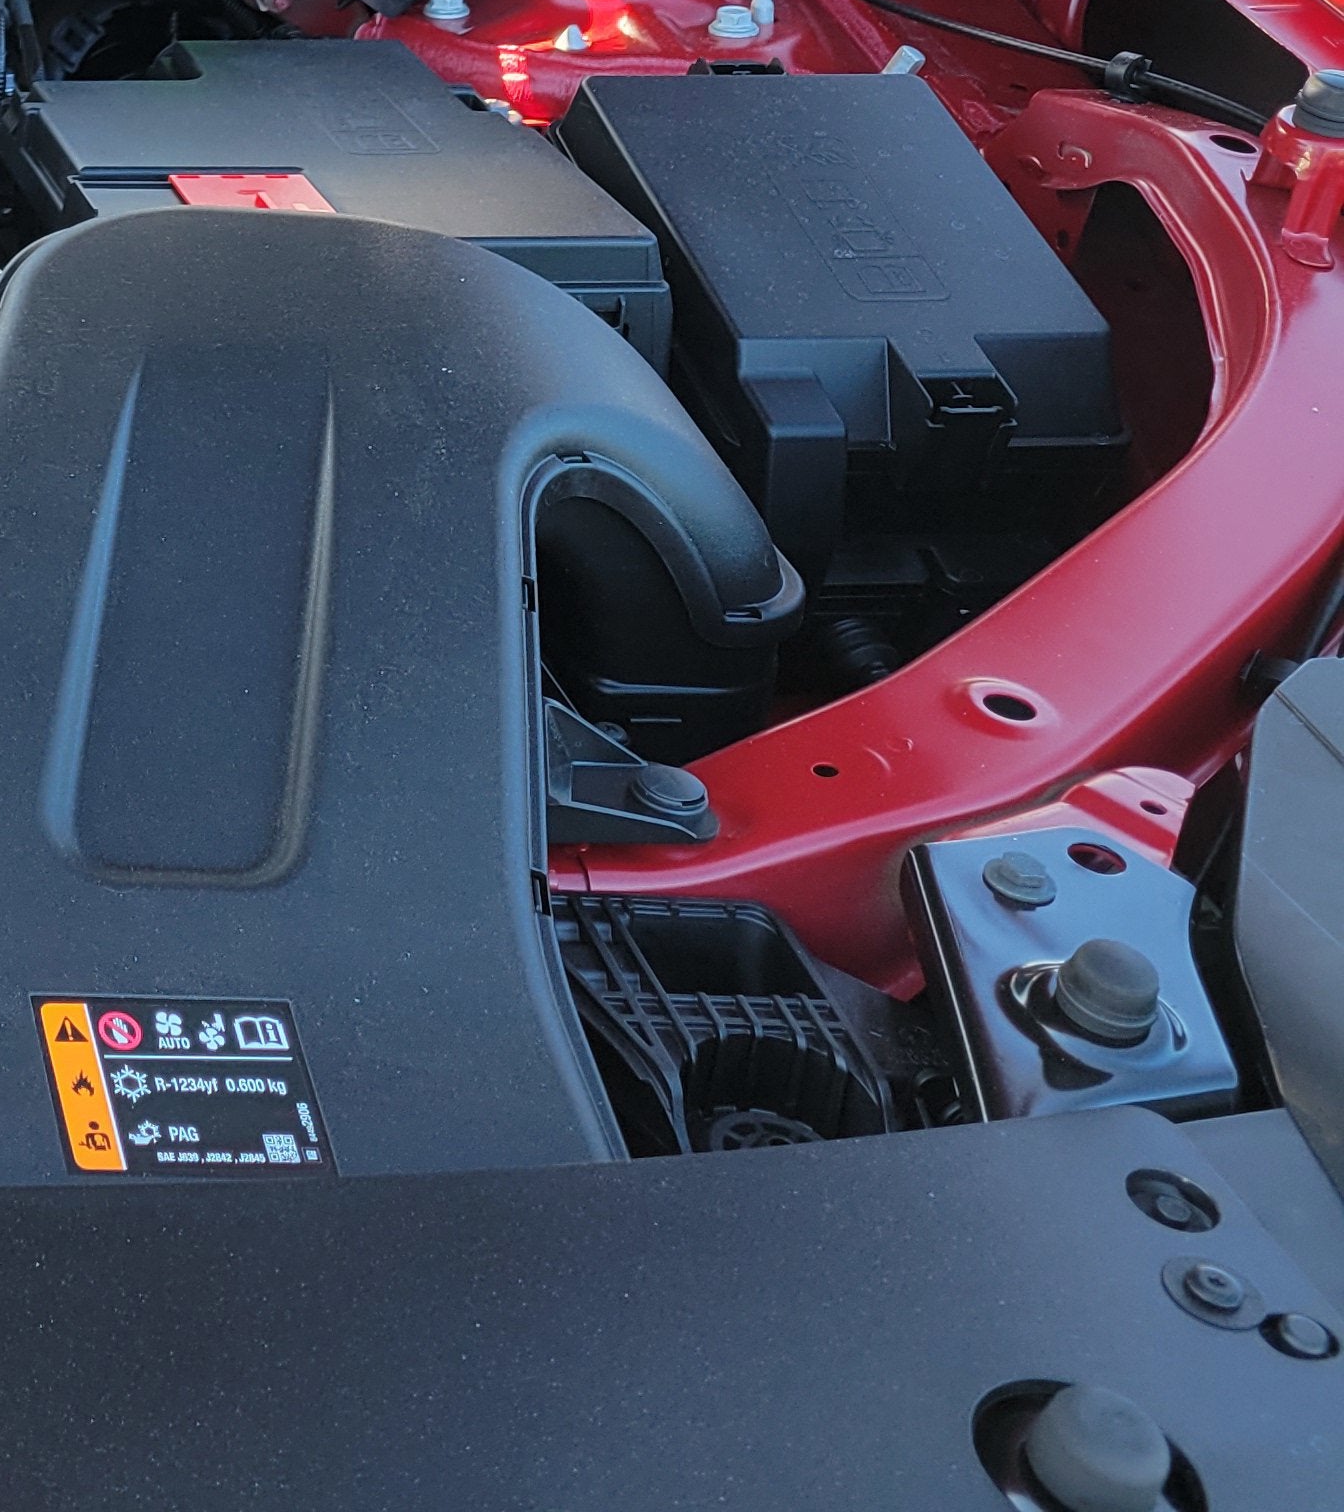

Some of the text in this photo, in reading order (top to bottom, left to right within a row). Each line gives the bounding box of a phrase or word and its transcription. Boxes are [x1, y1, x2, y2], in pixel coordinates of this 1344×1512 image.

[158, 1037, 191, 1050] AUTO
[154, 1077, 288, 1095] R-1234yf 0.600 kg
[168, 1126, 200, 1142] PAG
[156, 1151, 176, 1162] SAE
